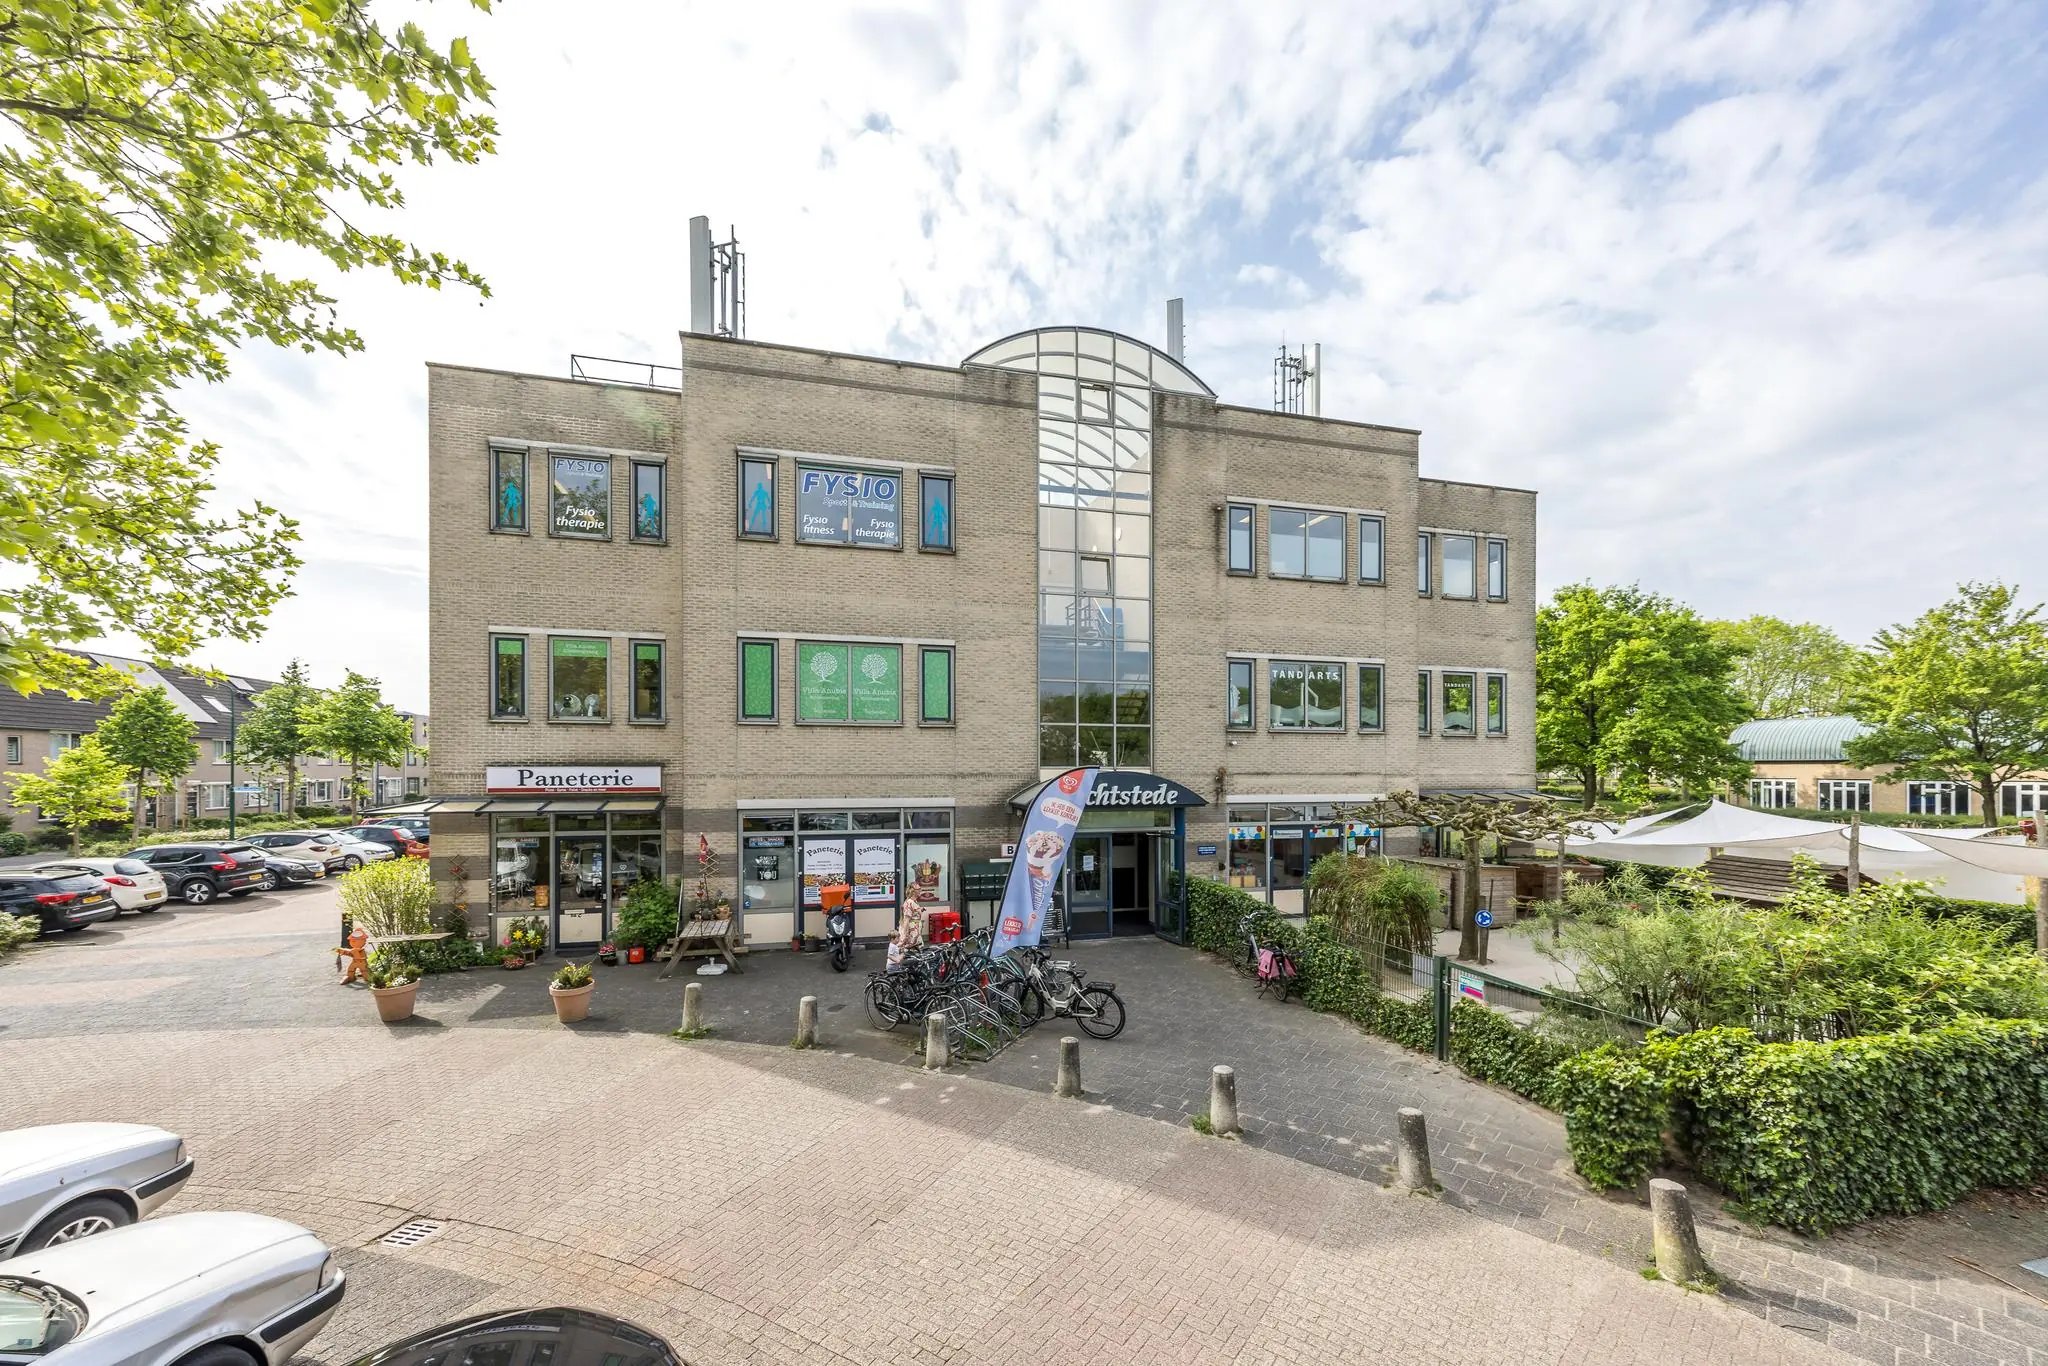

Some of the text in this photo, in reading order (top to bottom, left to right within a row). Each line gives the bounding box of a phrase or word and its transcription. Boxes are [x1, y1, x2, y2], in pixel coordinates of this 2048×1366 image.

[556, 459, 605, 473] FYSIO
[802, 471, 895, 500] FYSIO
[565, 505, 595, 517] Fysio
[556, 515, 605, 530] therapie
[803, 514, 828, 527] Fysio
[871, 518, 894, 529] Fysio
[803, 524, 835, 535] fitness
[855, 528, 894, 540] therapie
[516, 769, 633, 787] Paneterie
[1085, 782, 1179, 806] chtstede
[806, 846, 844, 857] Paneterie
[857, 845, 893, 856] Paneterie
